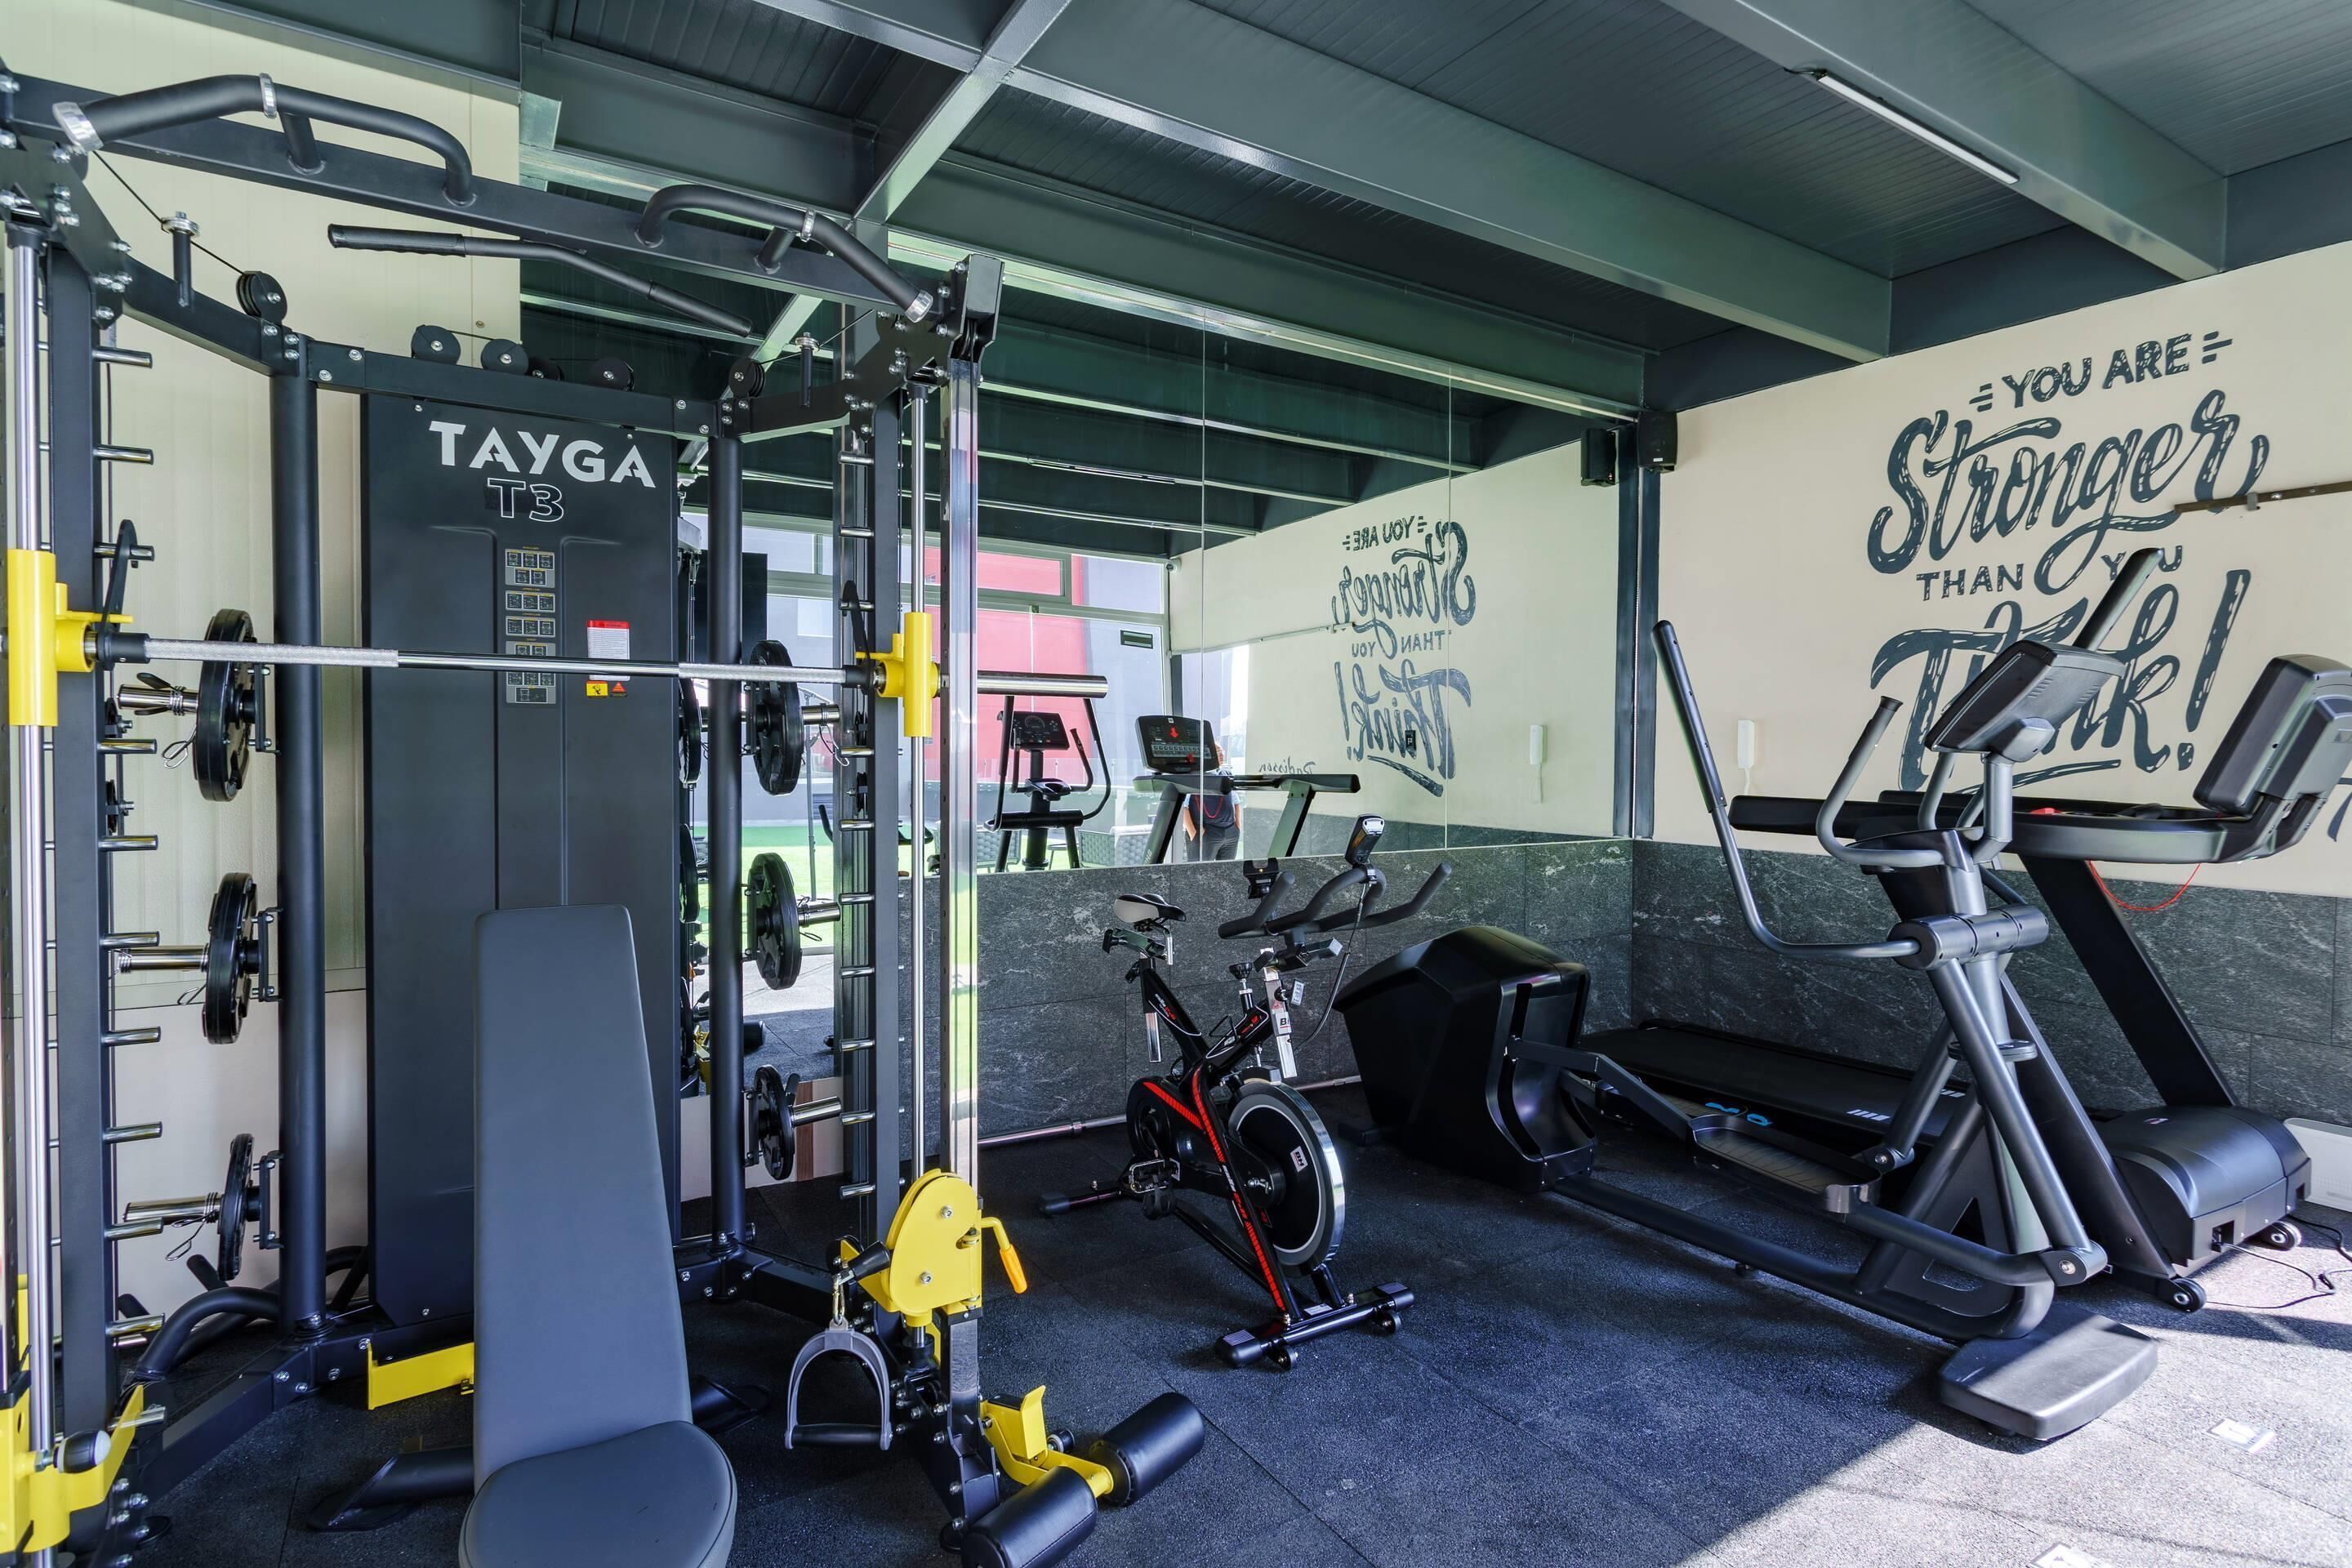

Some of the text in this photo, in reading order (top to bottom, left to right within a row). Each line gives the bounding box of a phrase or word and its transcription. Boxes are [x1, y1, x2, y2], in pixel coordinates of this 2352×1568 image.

[2001, 333, 2192, 408] YOU ARE
[429, 421, 656, 488] TAYGA
[487, 477, 564, 523] T3
[1868, 390, 2270, 595] Stronger
[1917, 546, 2183, 601] THAN YU
